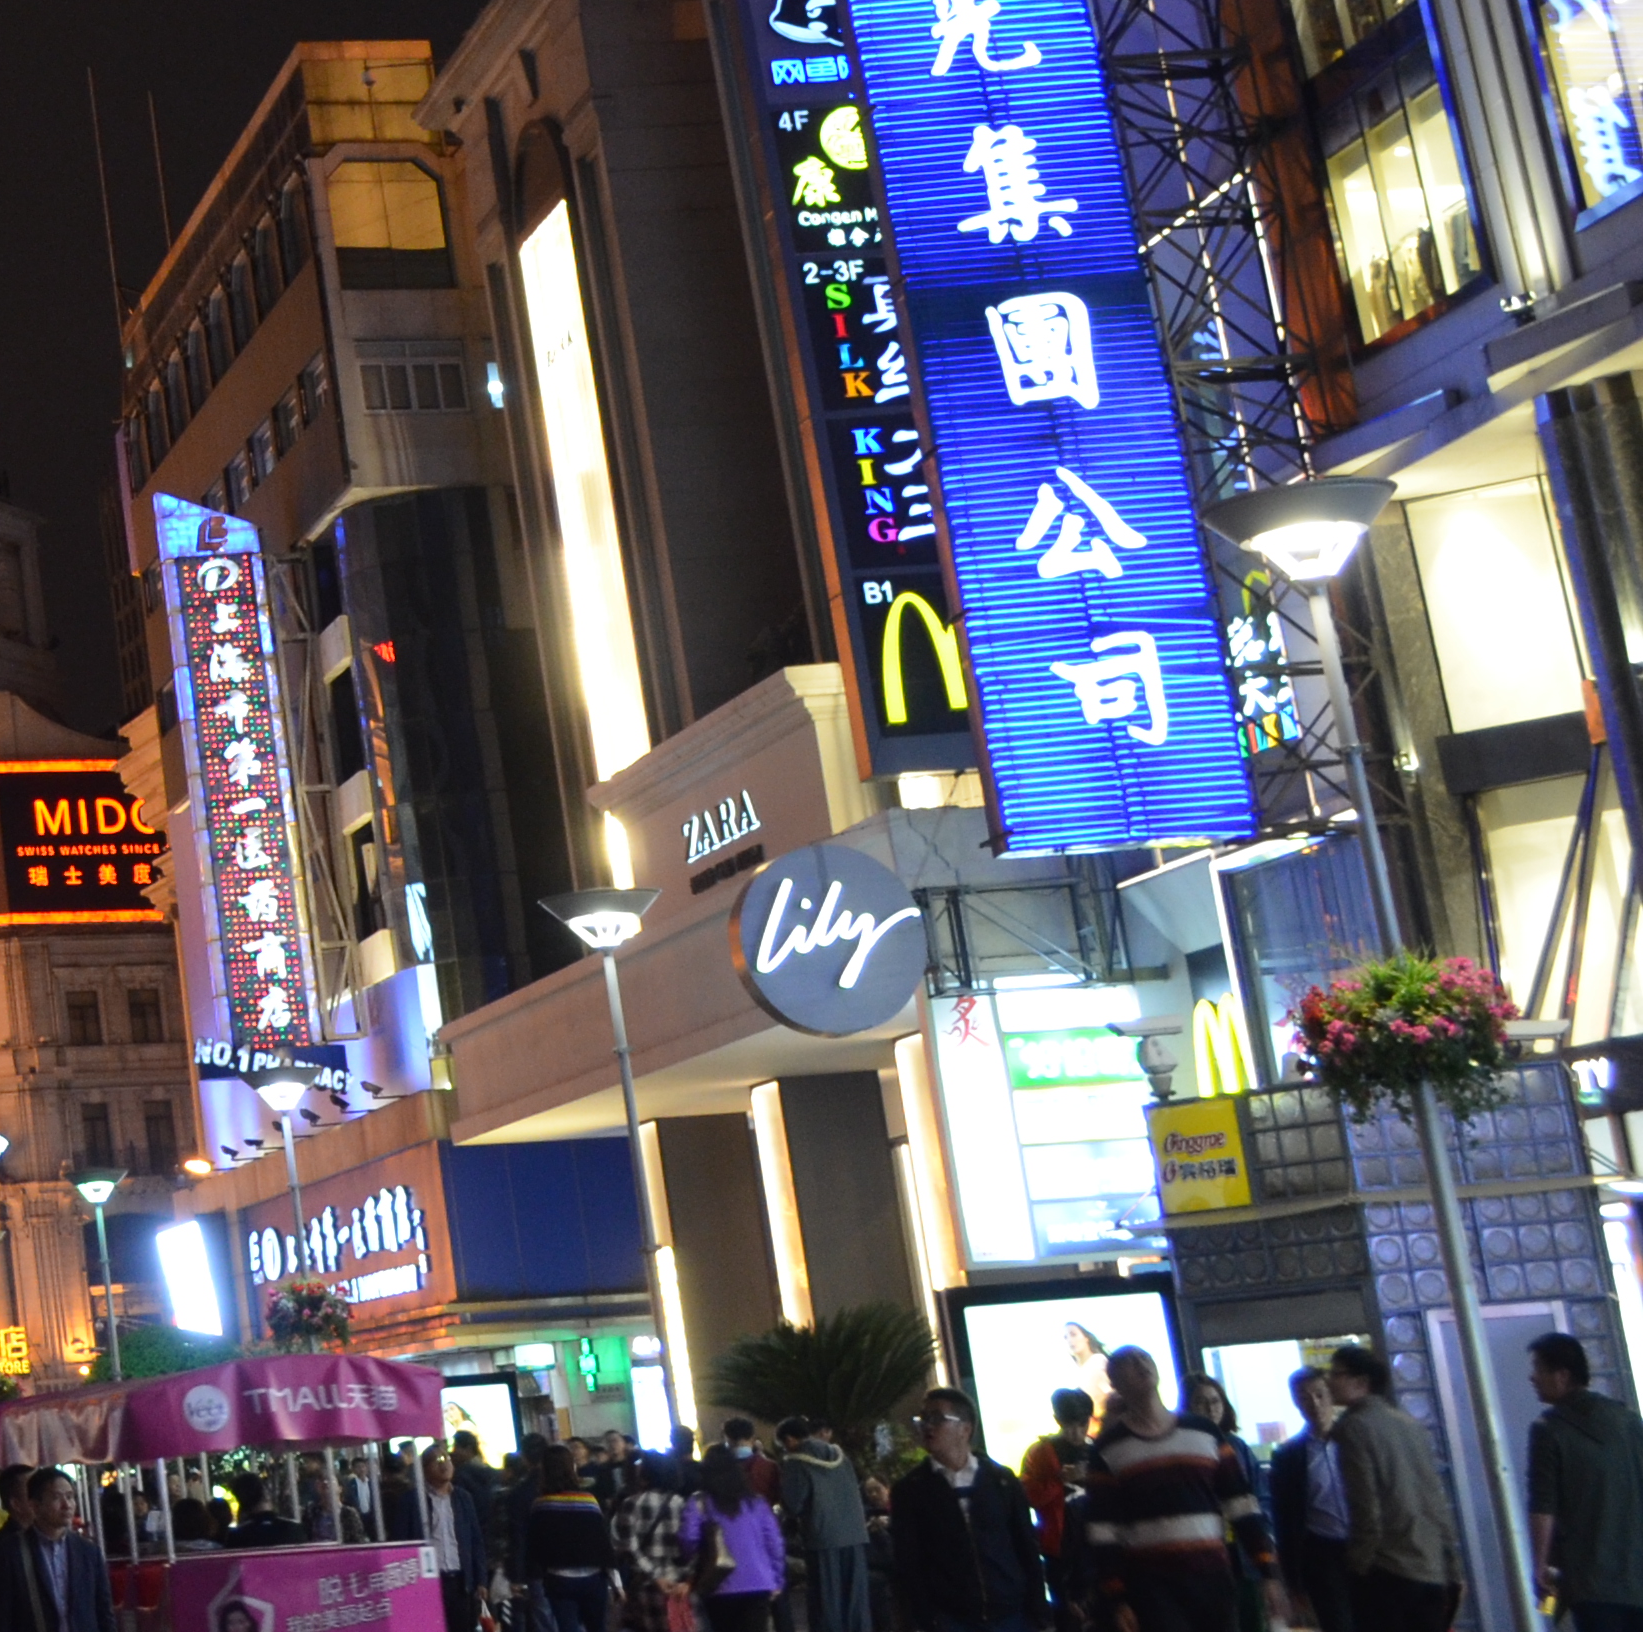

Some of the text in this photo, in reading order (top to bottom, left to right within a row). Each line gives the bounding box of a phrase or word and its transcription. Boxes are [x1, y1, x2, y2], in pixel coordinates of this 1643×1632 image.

[778, 110, 809, 132] 4F
[802, 260, 863, 284] 2-3F
[824, 283, 875, 398] SILK
[851, 428, 899, 543] KING
[863, 580, 893, 604] B1
[682, 789, 761, 864] ZARA
[17, 843, 160, 857] SWISS WATCHES SINCE
[253, 1052, 354, 1093] PHACY
